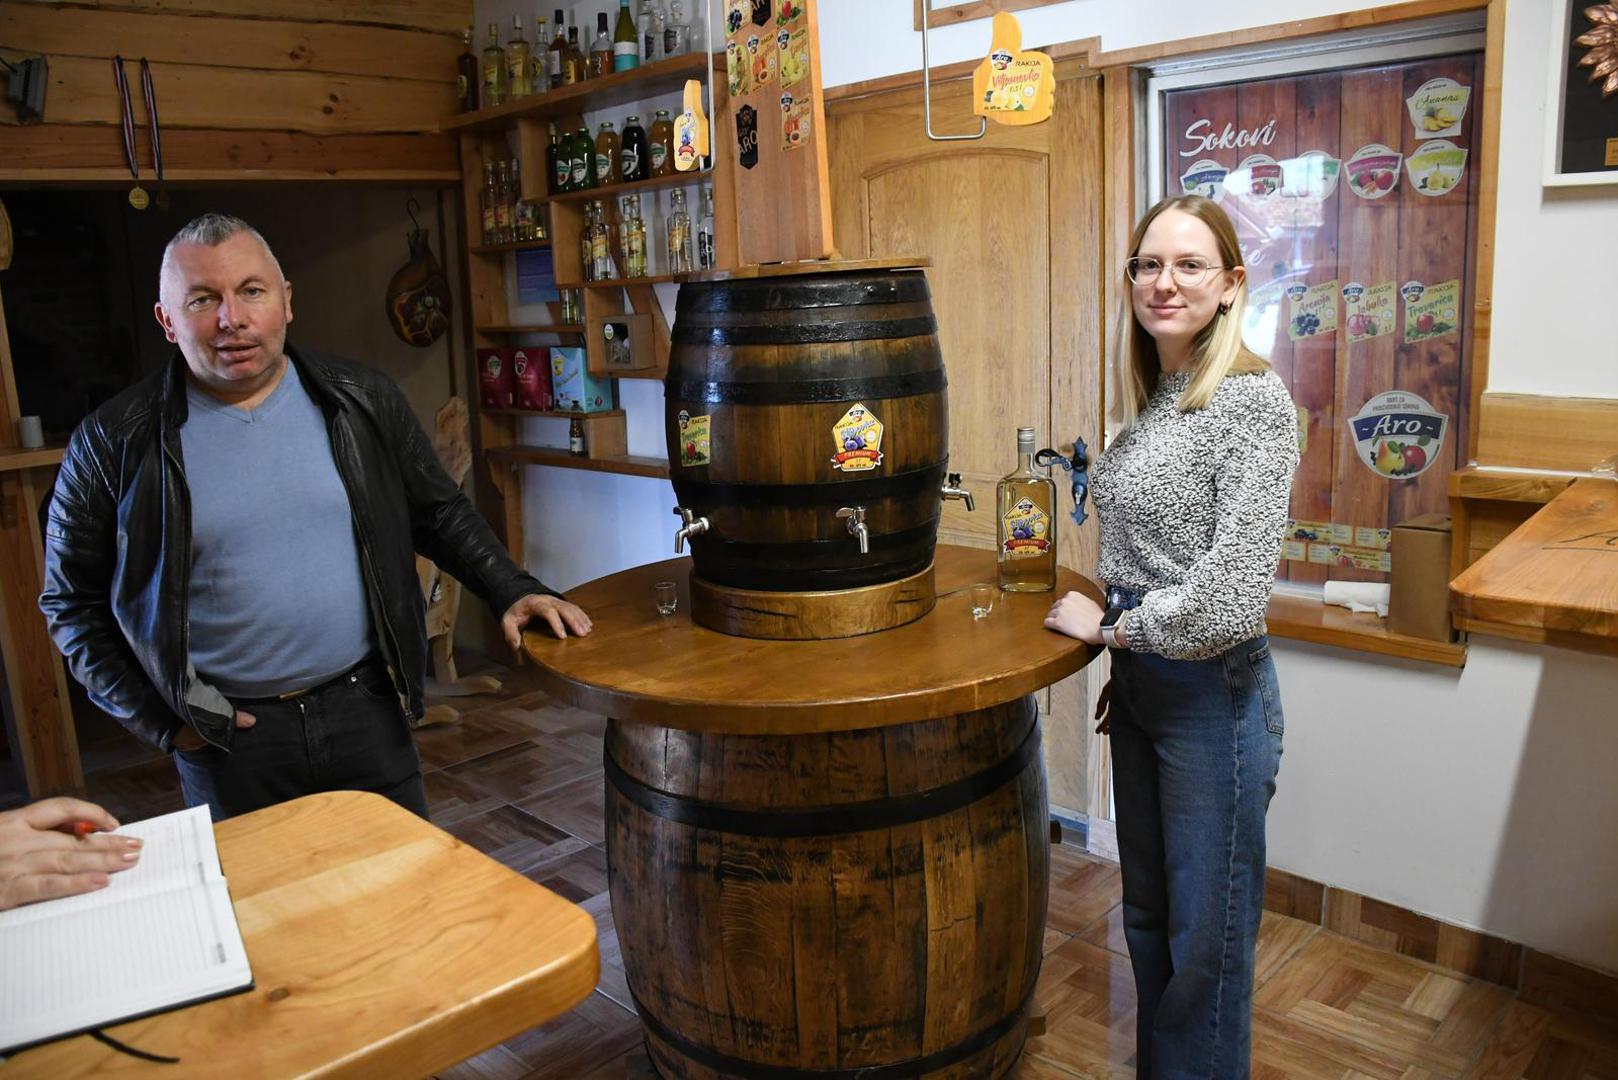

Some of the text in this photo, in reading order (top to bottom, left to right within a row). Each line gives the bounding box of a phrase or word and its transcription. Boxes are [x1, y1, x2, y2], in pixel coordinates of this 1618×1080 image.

[1015, 59, 1041, 67] RAKIJA
[1179, 119, 1277, 157] Sokovi
[1407, 294, 1453, 318] Travarica
[1371, 414, 1422, 438] Aro
